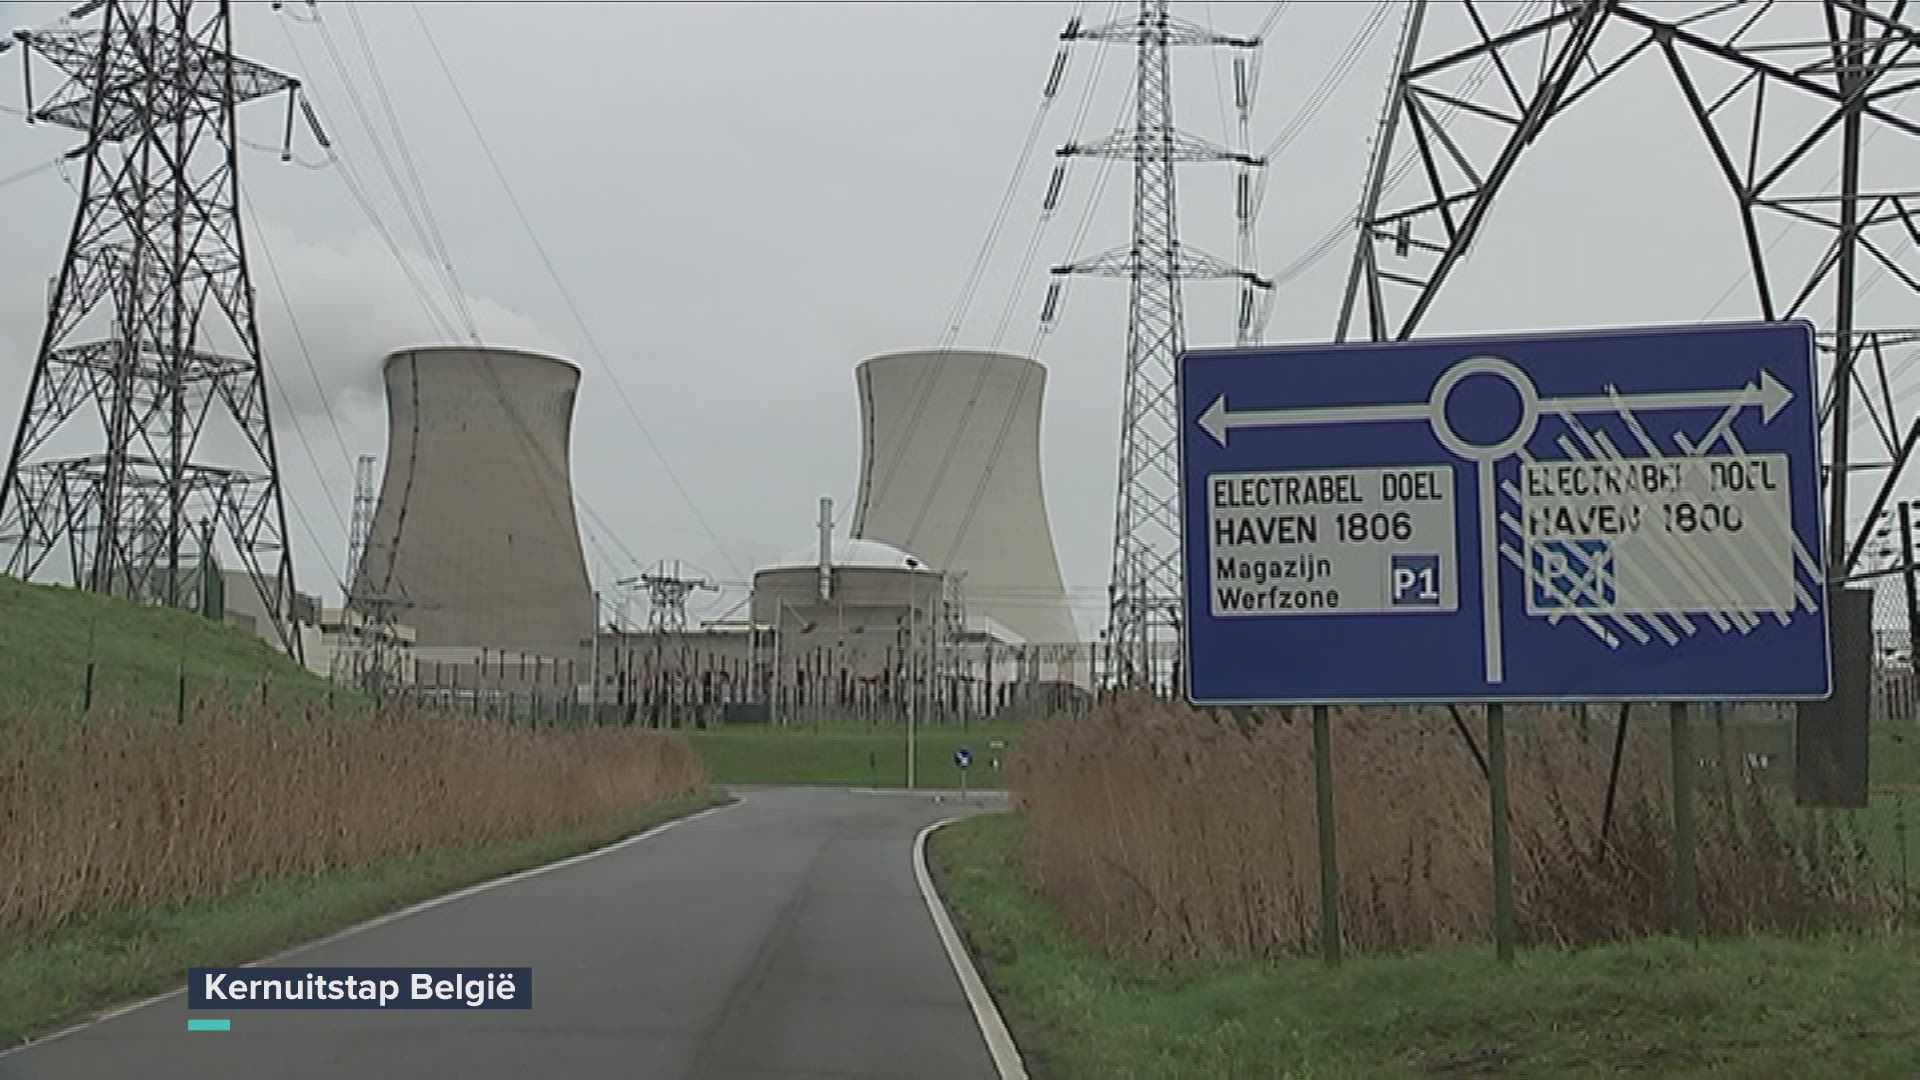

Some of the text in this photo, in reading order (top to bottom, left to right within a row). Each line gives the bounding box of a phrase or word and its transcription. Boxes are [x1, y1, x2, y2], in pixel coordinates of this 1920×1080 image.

[1214, 472, 1442, 508] ELECTRABEL DOEL
[1215, 512, 1412, 547] HAVEN 1806
[1216, 554, 1331, 584] Magazijn
[1393, 568, 1438, 600] P1
[1217, 586, 1339, 611] Werfzone
